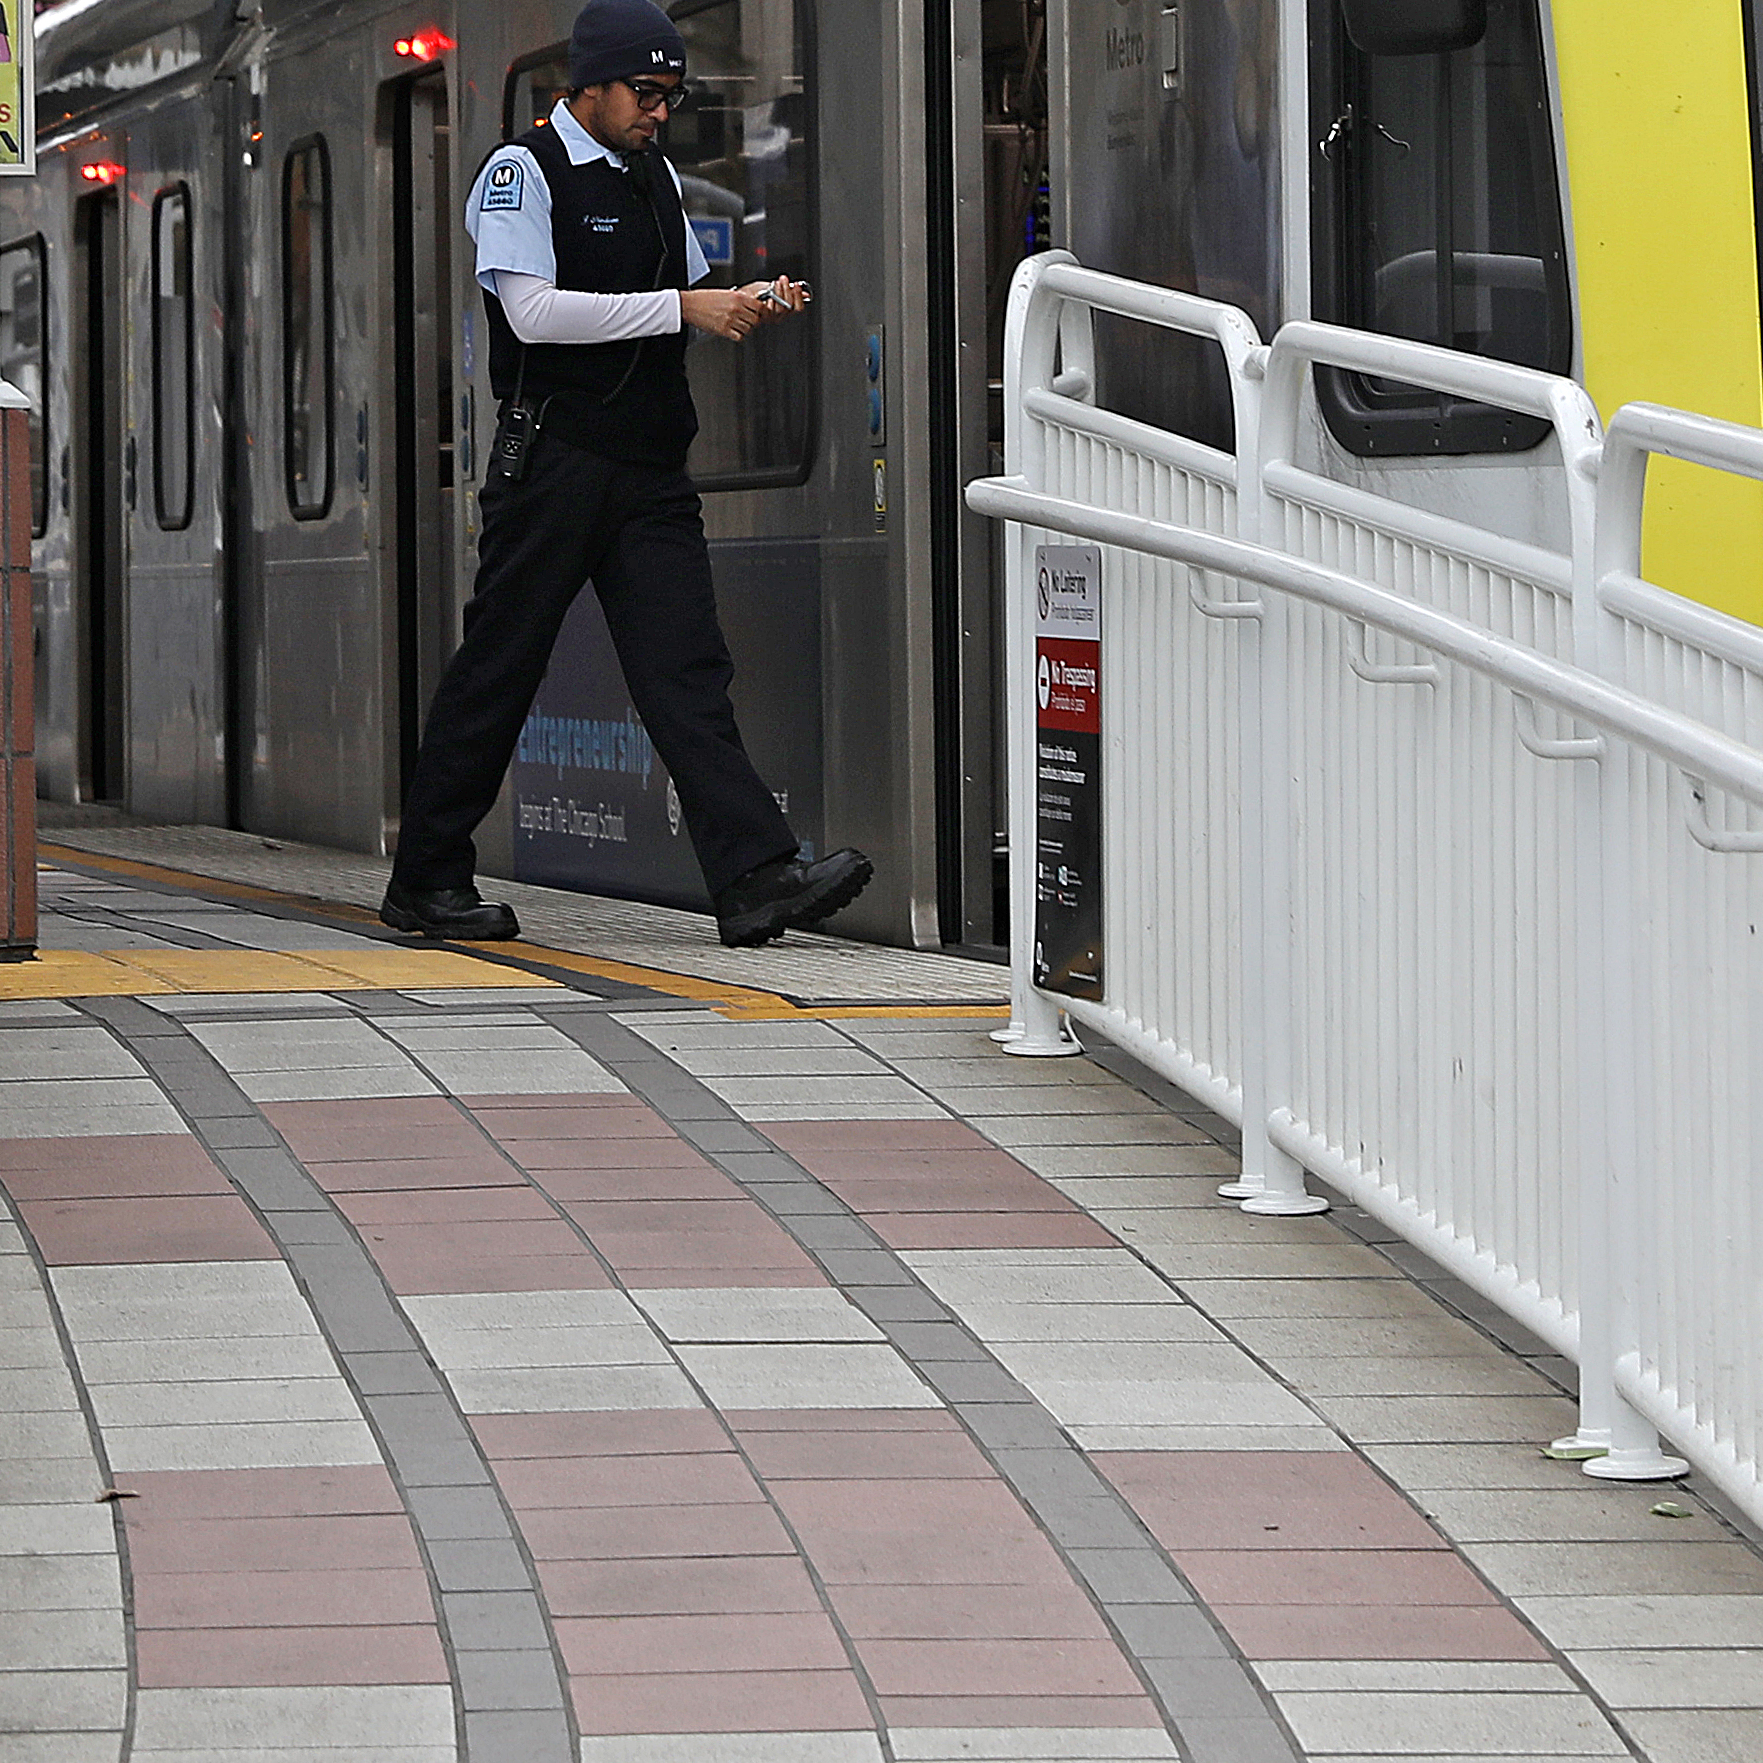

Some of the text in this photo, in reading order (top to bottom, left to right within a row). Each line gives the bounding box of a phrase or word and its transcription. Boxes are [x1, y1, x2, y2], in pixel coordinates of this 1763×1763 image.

[651, 49, 664, 64] M
[1106, 27, 1144, 71] Metro
[494, 168, 511, 185] M
[490, 189, 513, 197] Metro
[1051, 569, 1060, 593] No
[1051, 659, 1060, 684] No
[519, 794, 543, 840] begins
[567, 798, 598, 848] Chicago
